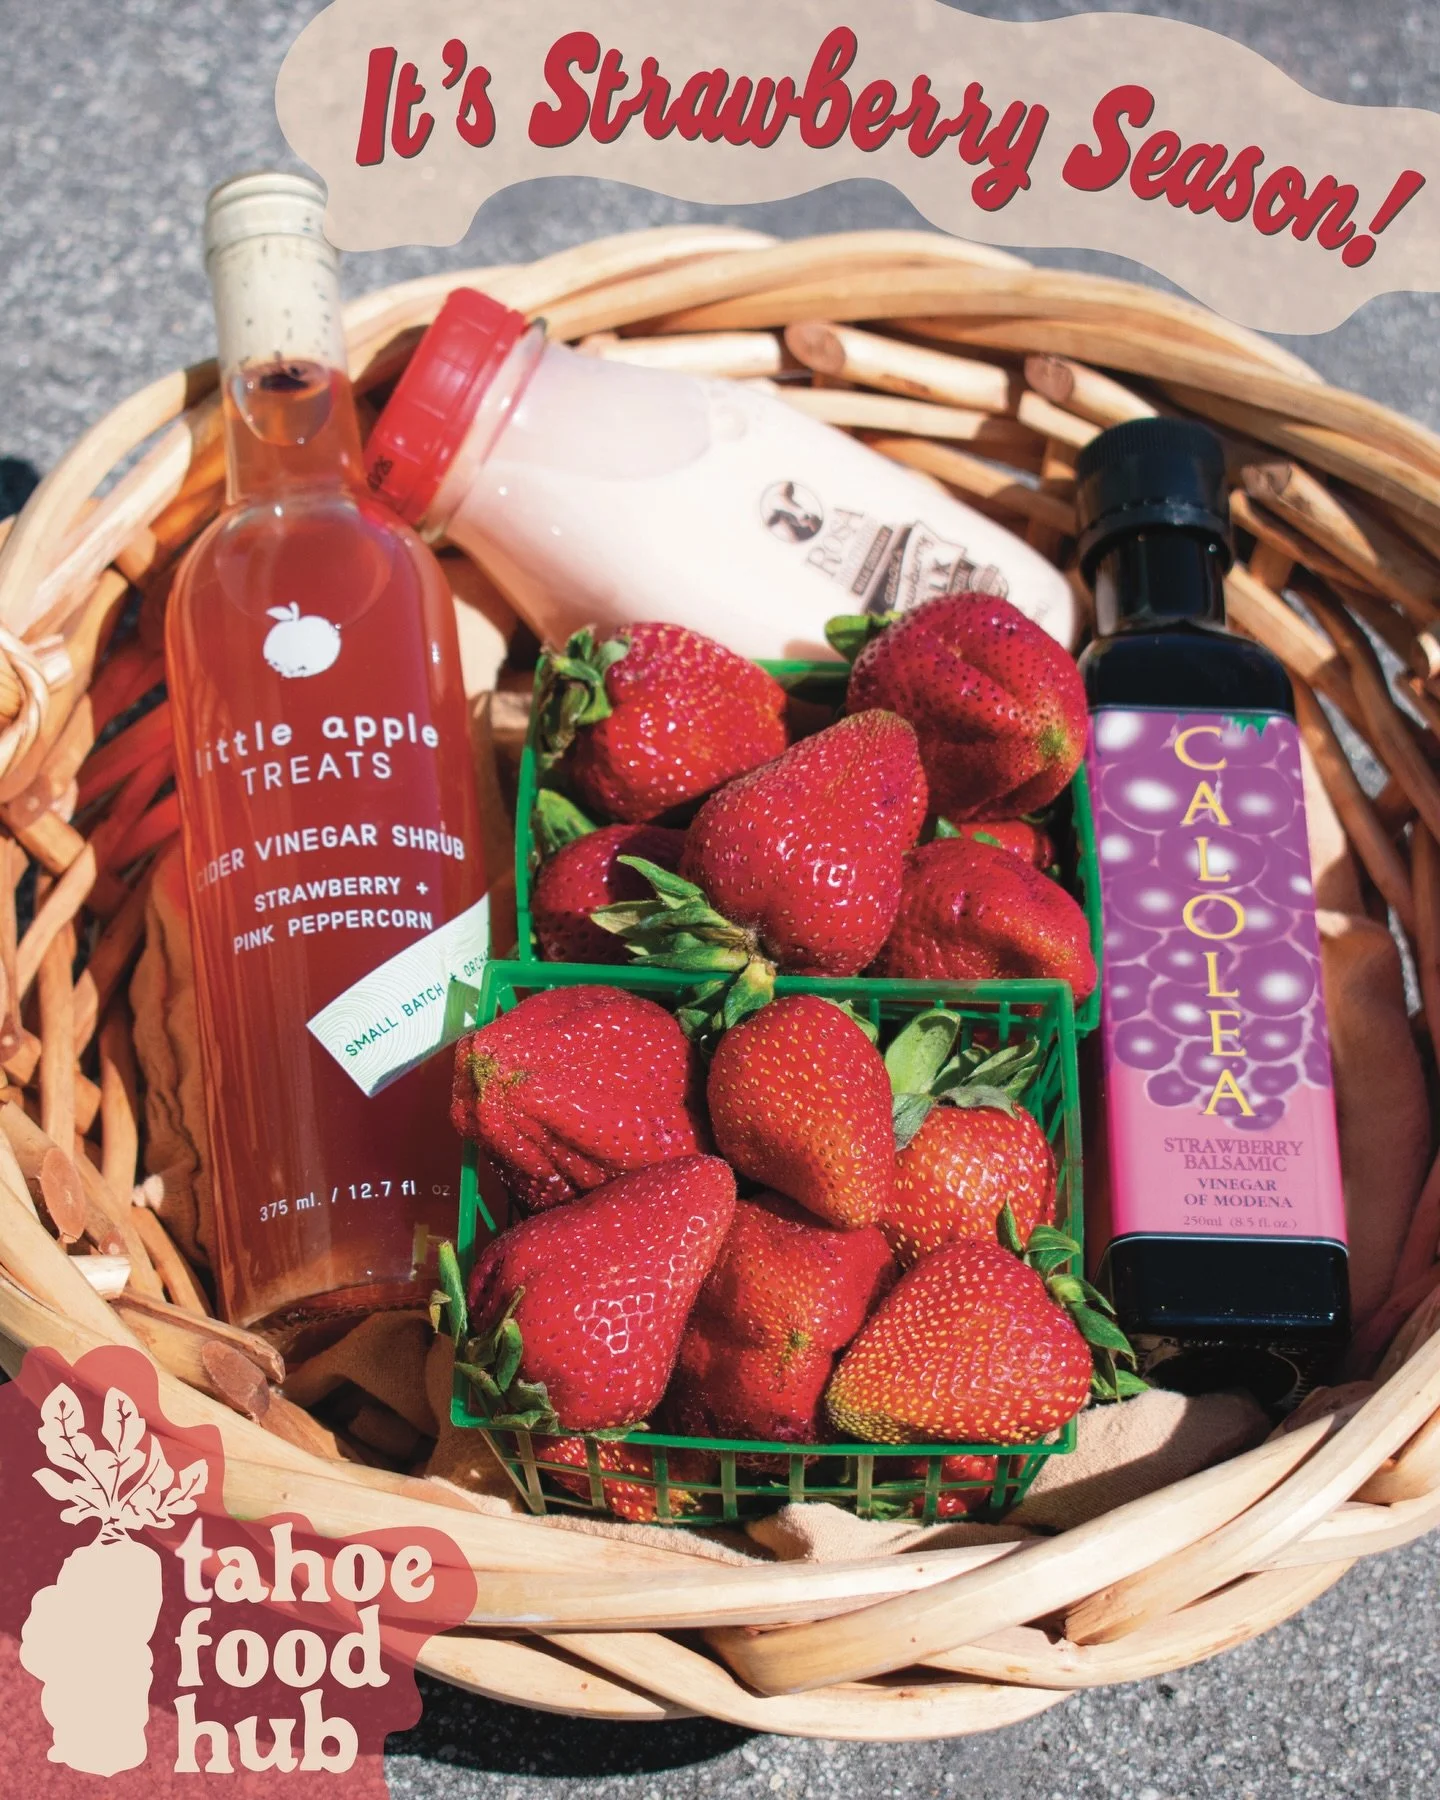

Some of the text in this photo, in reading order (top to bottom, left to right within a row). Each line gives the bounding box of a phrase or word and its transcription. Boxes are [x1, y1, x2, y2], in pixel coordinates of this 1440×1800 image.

[805, 507, 865, 577] ROSA
[195, 713, 439, 779] little apple
[241, 751, 393, 796] TREATS
[196, 823, 465, 892] CIDER VINEGAR SHRUB
[254, 876, 402, 912] STRAWBERRY
[234, 909, 433, 954] PINK PEPPERCORN
[1174, 726, 1257, 1117] CALOLEA
[345, 1017, 399, 1057] SMALL
[401, 982, 445, 1017] BATCH
[1164, 1137, 1303, 1156] STRAWBERRY
[1184, 1154, 1288, 1172] BALSAMIC
[259, 1199, 289, 1222] 375
[296, 1191, 322, 1211] ml.
[348, 1181, 392, 1200] 12.7
[1184, 1193, 1293, 1208] OF MODENA
[1197, 1178, 1277, 1191] VINEGAR
[1183, 1215, 1223, 1227] 250ml
